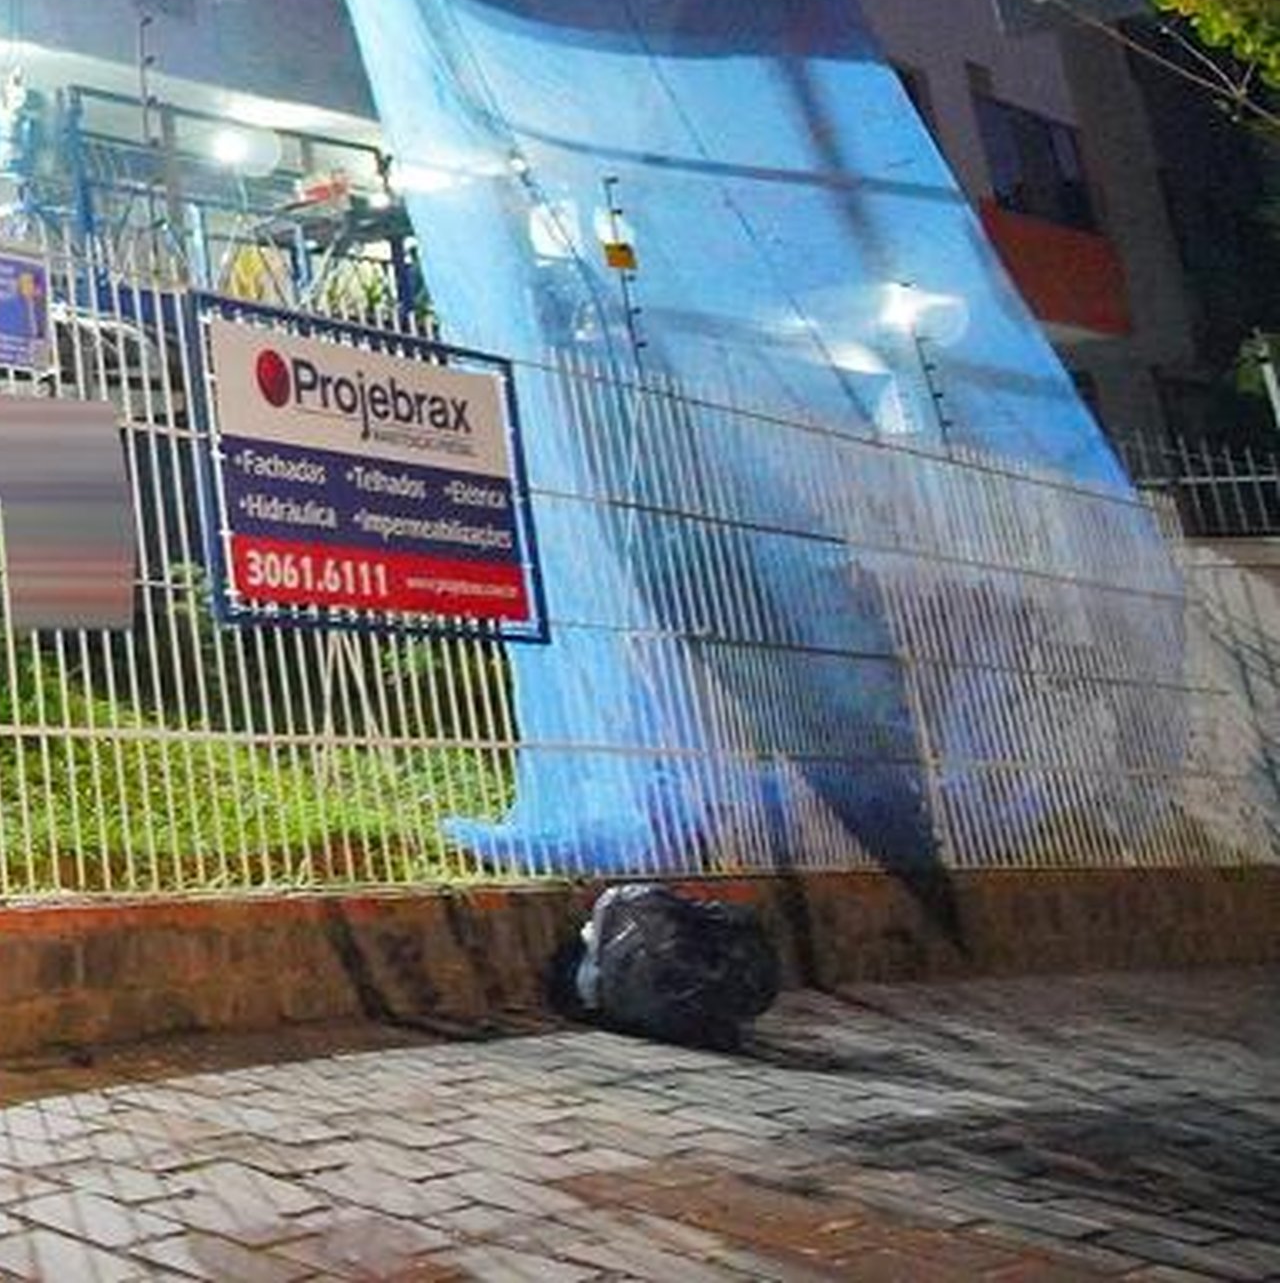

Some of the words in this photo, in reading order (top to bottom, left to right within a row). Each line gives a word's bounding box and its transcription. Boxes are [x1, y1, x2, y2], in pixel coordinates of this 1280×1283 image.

[292, 358, 471, 440] Projebrax
[243, 449, 325, 484] Fachadas
[354, 466, 425, 499] Telhados
[246, 550, 388, 596] 3061.6111
